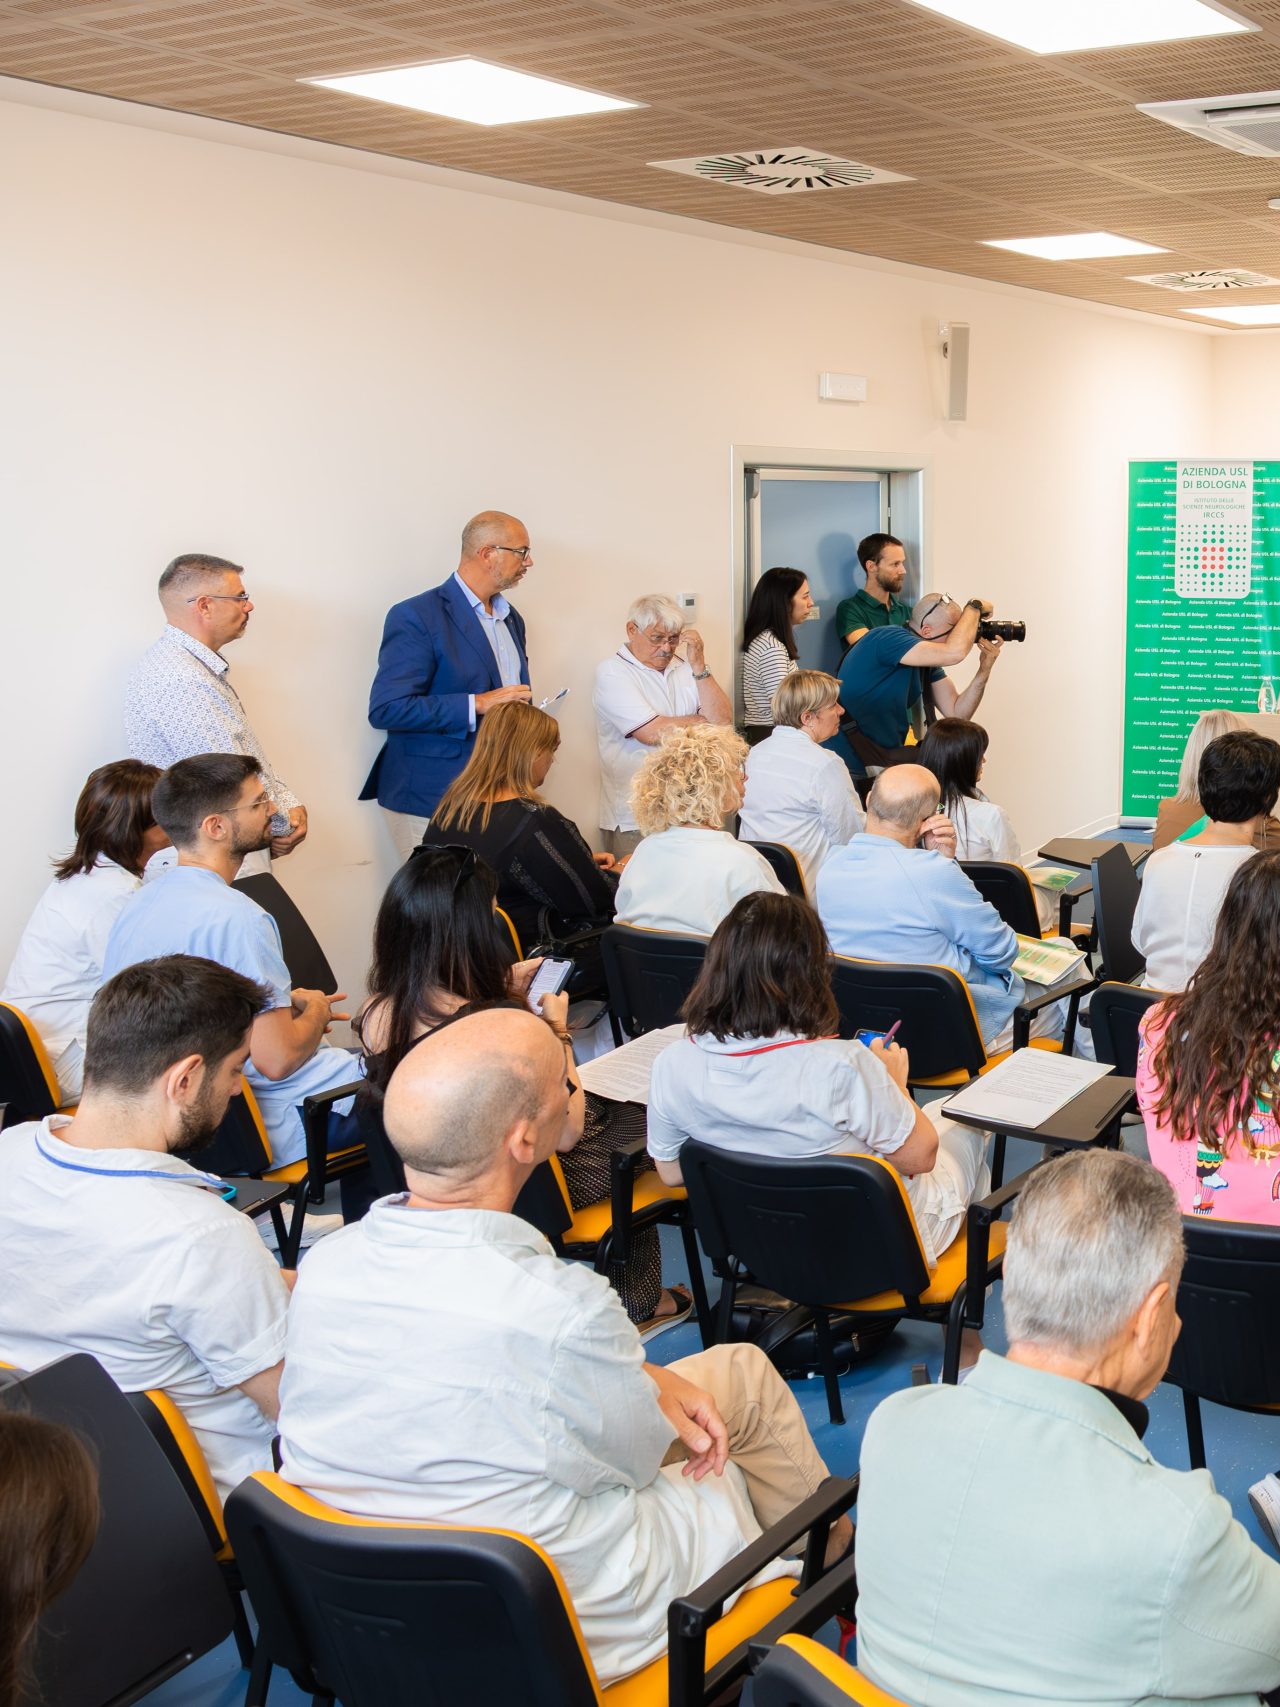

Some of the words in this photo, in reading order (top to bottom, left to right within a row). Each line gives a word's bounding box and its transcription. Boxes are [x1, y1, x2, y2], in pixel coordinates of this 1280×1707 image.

[1182, 467, 1226, 476] AZIENDA
[1230, 467, 1248, 476] USL
[1183, 480, 1193, 489] DI
[1196, 480, 1247, 489] BOLOGNA
[1203, 511, 1225, 519] IRCCS
